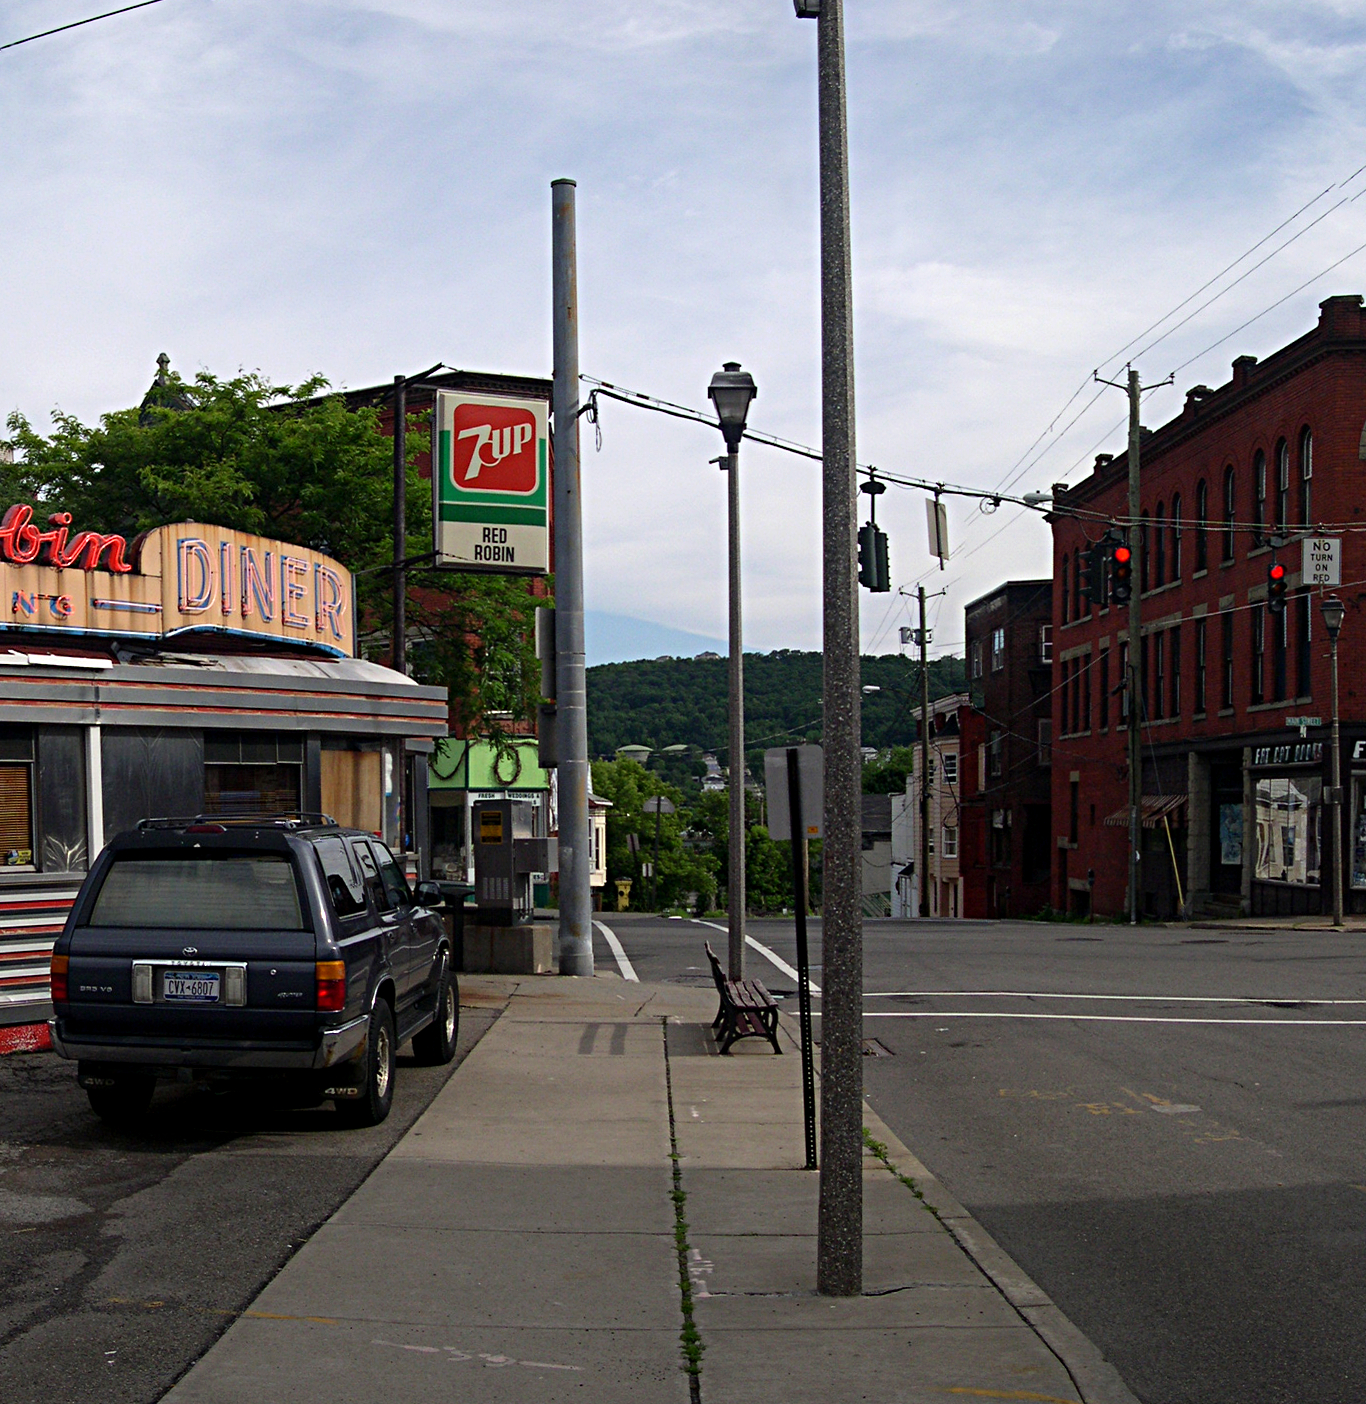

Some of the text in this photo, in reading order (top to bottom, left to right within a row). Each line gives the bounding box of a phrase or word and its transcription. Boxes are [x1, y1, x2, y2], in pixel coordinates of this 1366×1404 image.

[457, 423, 532, 480] 7UP
[483, 527, 507, 544] RED
[1313, 542, 1331, 551] NO
[474, 545, 515, 562] ROBIN
[1310, 553, 1333, 561] TURN
[1315, 563, 1328, 571] ON
[176, 536, 346, 640] DINER
[1255, 747, 1271, 764] FAT
[1273, 745, 1291, 763] CAT
[84, 1078, 116, 1087] 4WD
[324, 1087, 358, 1096] 4WD
